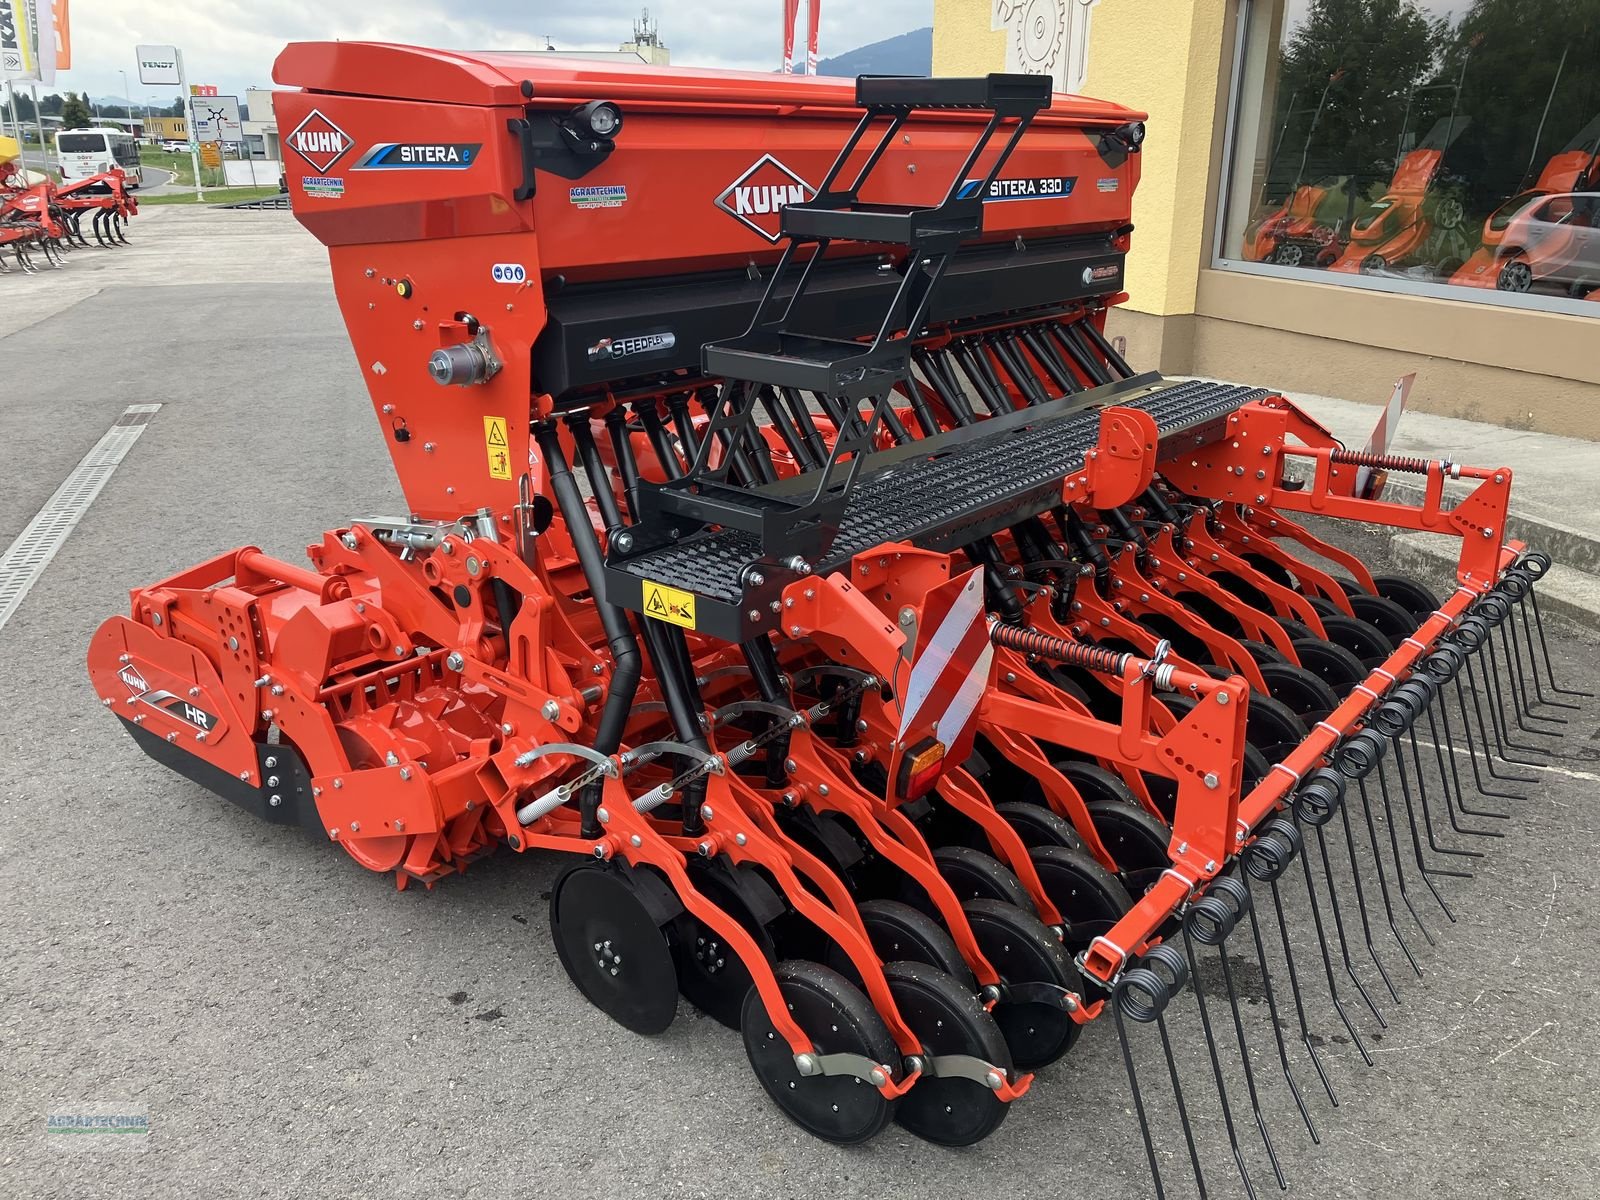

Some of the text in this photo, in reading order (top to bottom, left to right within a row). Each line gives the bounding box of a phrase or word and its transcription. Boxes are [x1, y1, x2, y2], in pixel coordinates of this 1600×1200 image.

[141, 61, 175, 69] FENDT
[296, 131, 344, 153] KUHN
[400, 146, 460, 162] SITERA
[303, 177, 343, 187] AGRARTECHNIK
[570, 186, 626, 197] AGRARTECHNIK
[989, 179, 1037, 197] SITERA
[1039, 178, 1062, 194] 330
[735, 184, 805, 215] KUHN
[611, 335, 665, 359] SEEDFLEX
[121, 671, 147, 692] KUHN
[184, 703, 209, 730] HR
